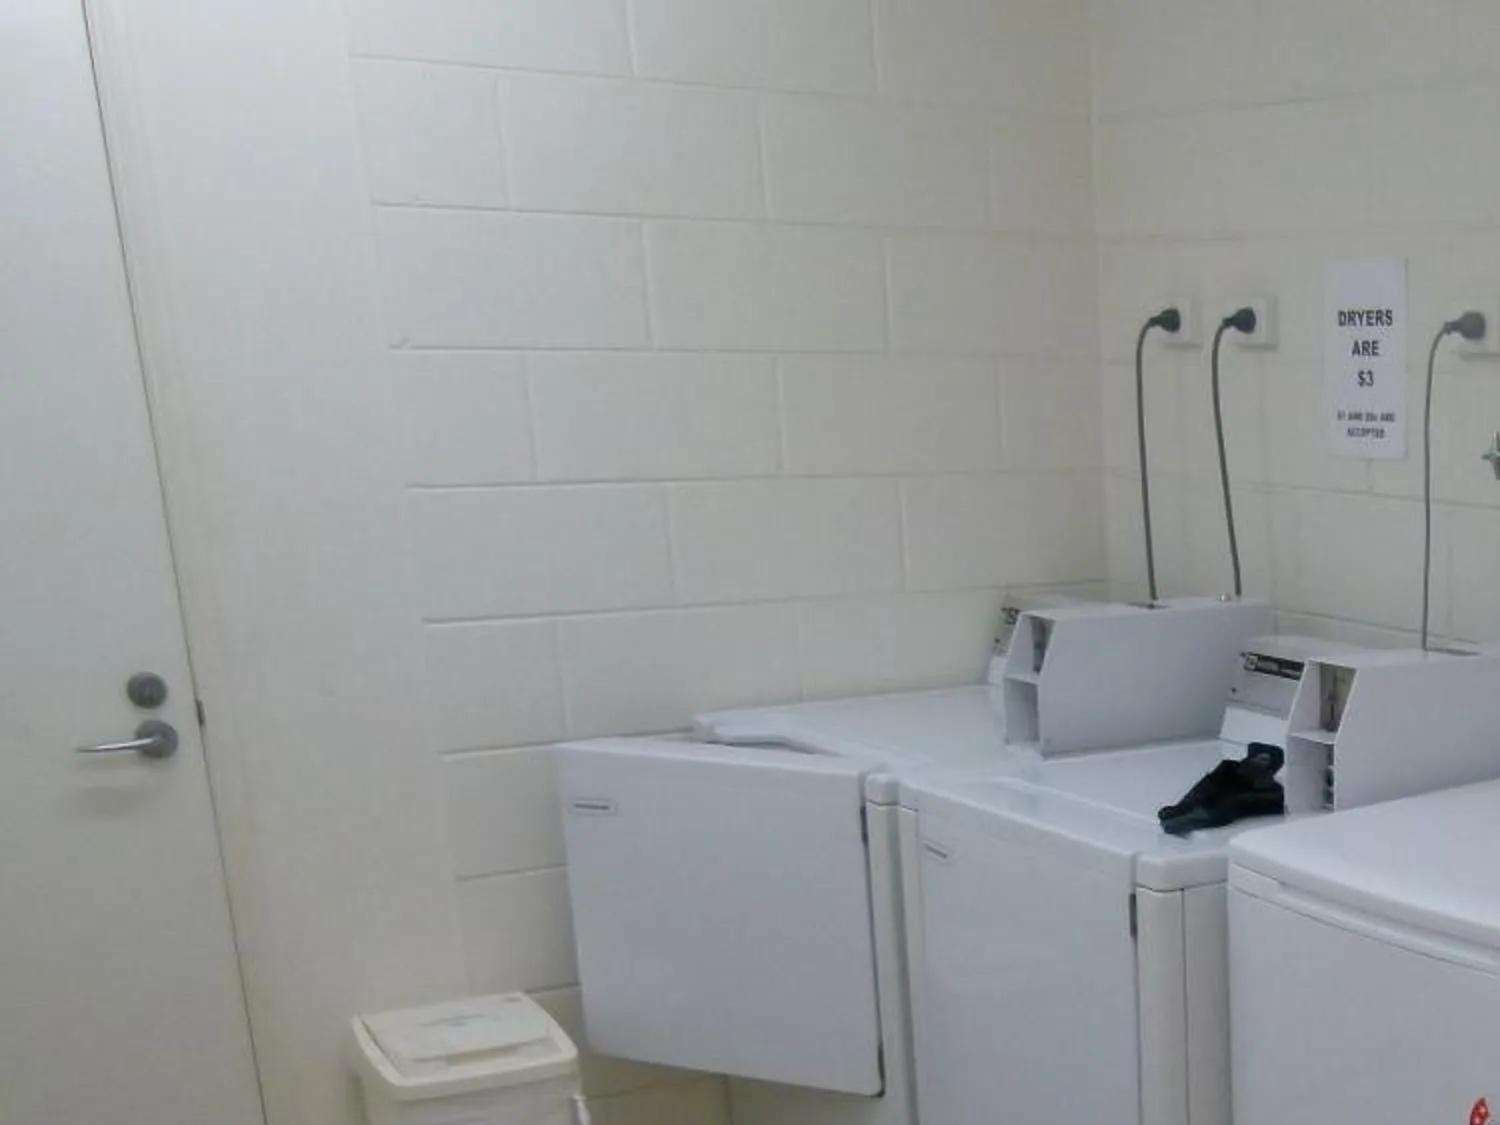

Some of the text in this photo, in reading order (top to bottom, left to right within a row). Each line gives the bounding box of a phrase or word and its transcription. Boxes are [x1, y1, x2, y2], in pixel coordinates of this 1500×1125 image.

[1337, 309, 1394, 327] DRYERS
[1351, 340, 1380, 357] ARE
[1357, 370, 1375, 387] $3
